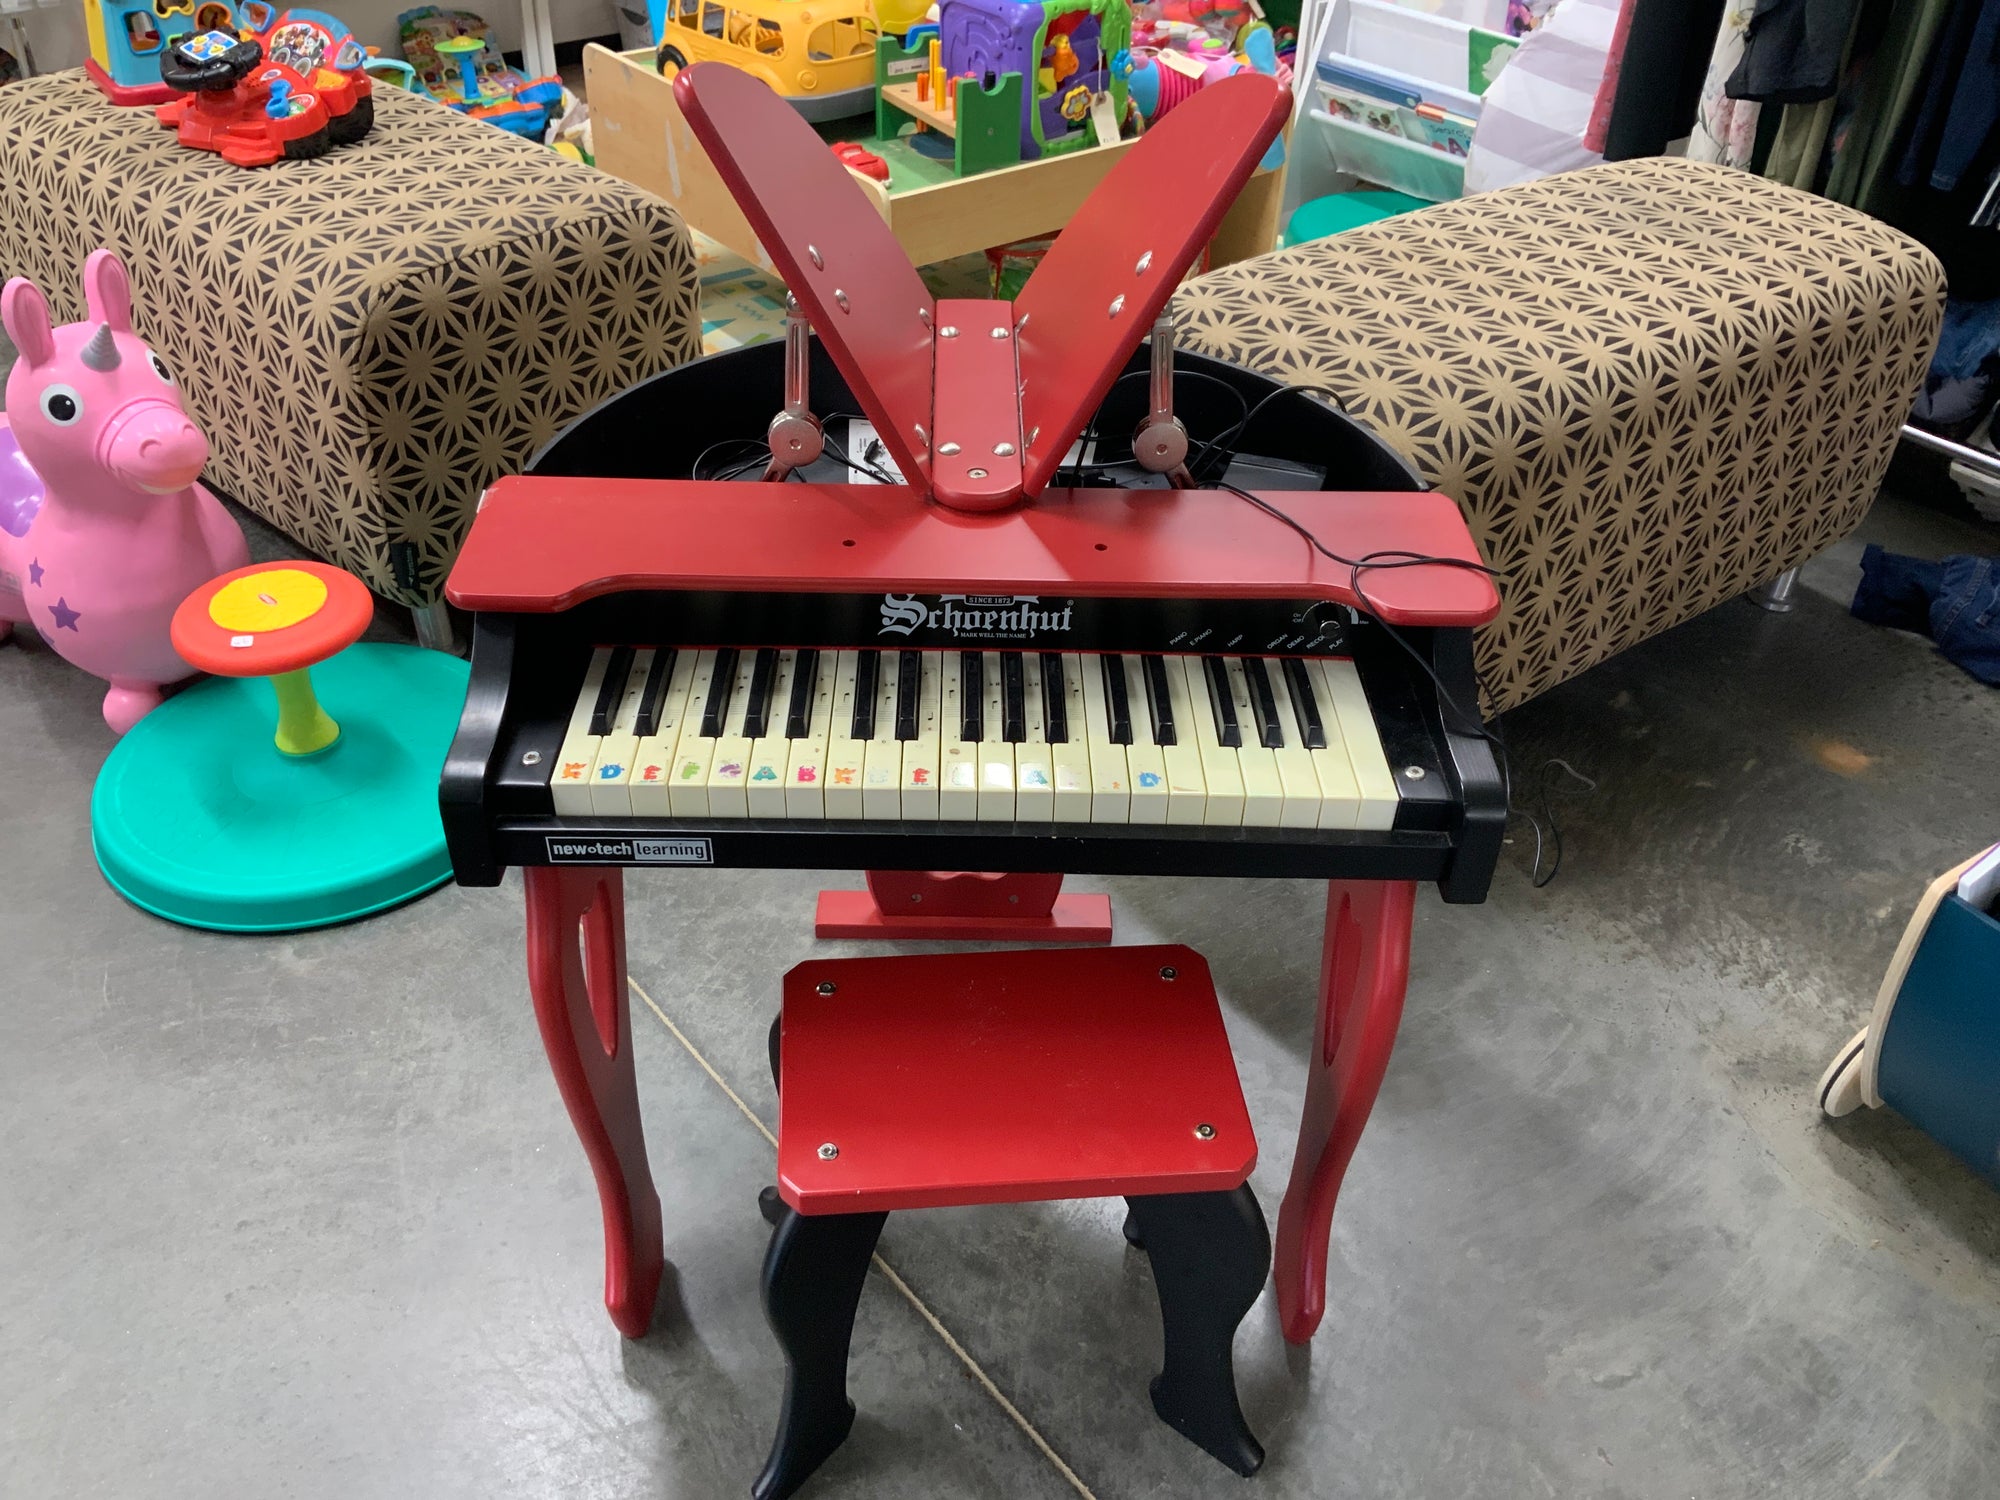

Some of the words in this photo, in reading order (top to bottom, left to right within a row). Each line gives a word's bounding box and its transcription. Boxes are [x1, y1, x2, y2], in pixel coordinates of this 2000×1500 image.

[968, 596, 993, 604] SINCE
[994, 596, 1011, 604] 1872
[877, 593, 1073, 638] Schoenhut
[1169, 631, 1188, 646] PIANO
[1227, 634, 1243, 648] HARP
[1266, 633, 1288, 650] ORGAN
[1287, 635, 1305, 649] DEMO
[1328, 638, 1344, 650] PLAY
[636, 842, 704, 859] learning
